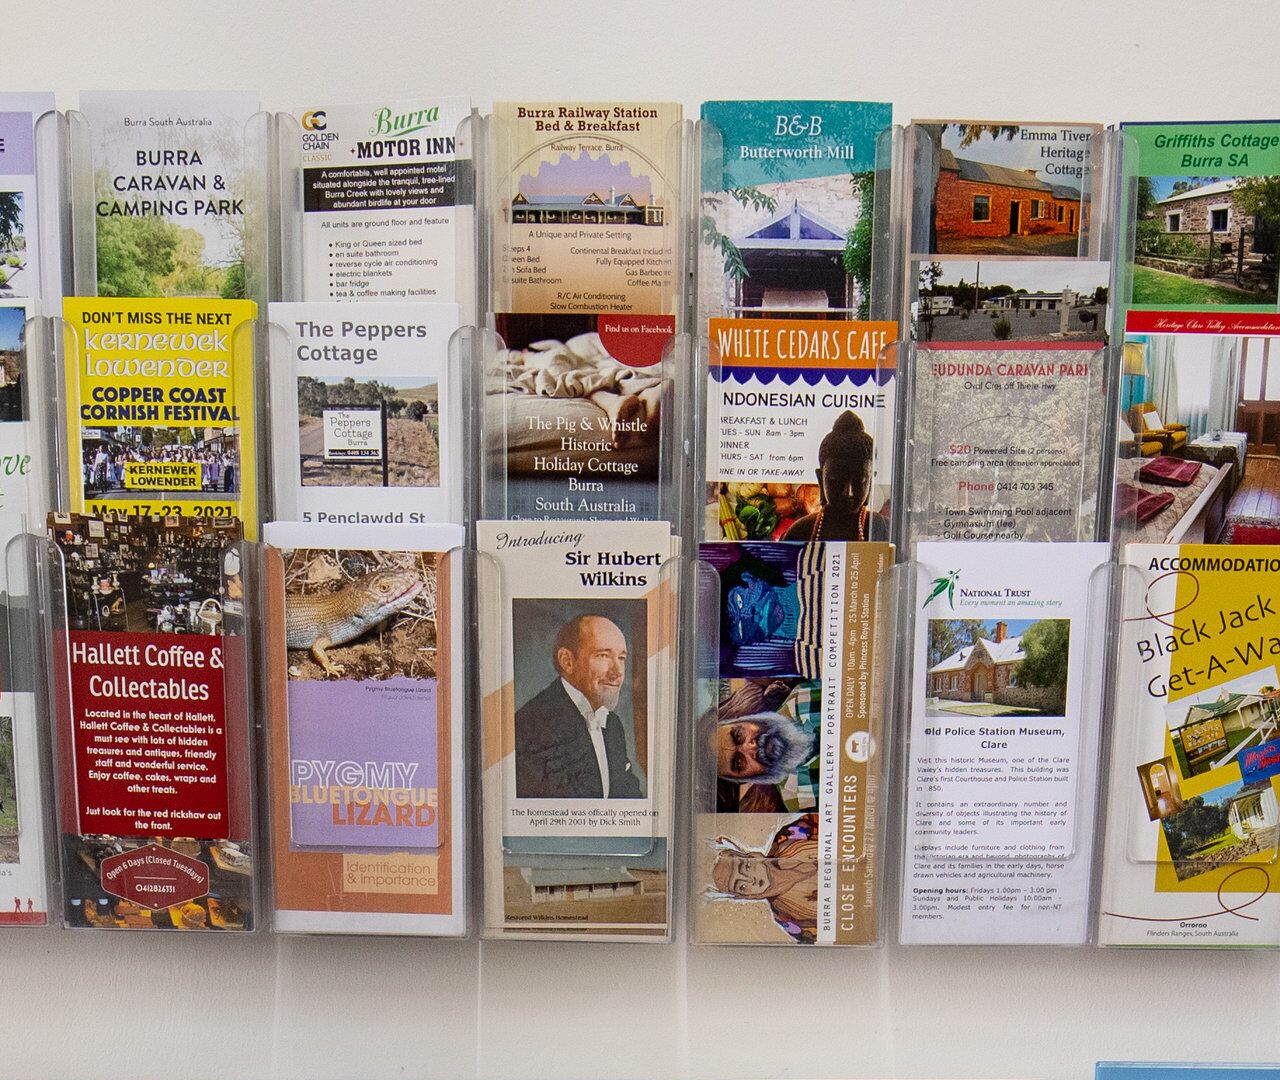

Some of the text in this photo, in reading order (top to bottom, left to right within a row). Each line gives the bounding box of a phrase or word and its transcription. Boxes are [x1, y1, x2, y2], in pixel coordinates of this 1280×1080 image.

[125, 118, 212, 126] Burra South Australia
[518, 107, 658, 121] Burra Railway Station
[535, 120, 640, 132] Bed & Breakfast
[775, 114, 822, 136] B&B
[357, 137, 455, 159] MOTOR INN
[1154, 134, 1280, 150] Griffiths Cottage
[136, 151, 202, 166] BURRA
[740, 145, 854, 160] Butterworth Mill
[1181, 153, 1249, 168] Burra SA
[114, 176, 226, 191] CARAVAN &
[97, 200, 244, 217] CAMPING PARK
[297, 322, 427, 342] The Peppers
[84, 328, 228, 353] kernewek
[718, 328, 887, 360] WHITE CEDARS CAFE
[297, 345, 377, 364] Cottage
[86, 354, 229, 378] lowender
[93, 388, 226, 403] COPPER COAST
[81, 405, 240, 420] CORNISH FESTIVAL
[959, 482, 1054, 491] Phone 0414 703 345
[565, 551, 661, 565] Sir Hubert
[580, 572, 647, 586] Wilkins
[73, 643, 224, 669] Hallett Coffee &
[90, 676, 209, 701] Collectables
[293, 760, 417, 790] PYGMY
[333, 803, 436, 826] LIZARD
[841, 774, 857, 931] CLOSE ENCOUNTERS
[136, 884, 175, 893] 0412826331
